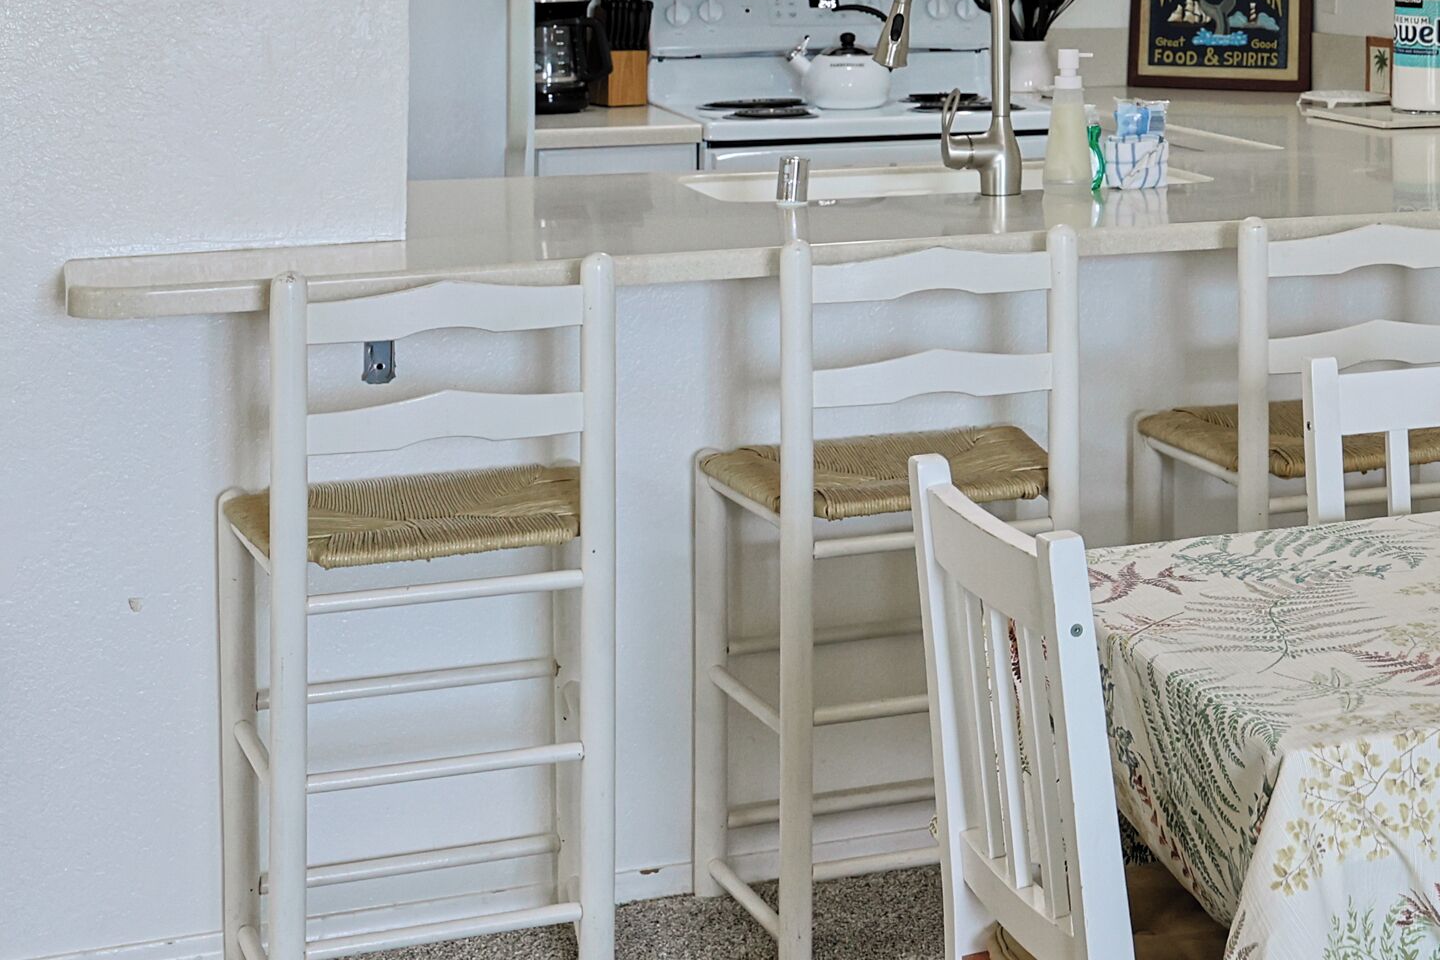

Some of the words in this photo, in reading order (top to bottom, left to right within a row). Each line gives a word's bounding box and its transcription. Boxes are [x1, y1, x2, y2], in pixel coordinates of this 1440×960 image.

[1155, 36, 1186, 48] Great
[1251, 39, 1278, 50] Good
[1204, 47, 1220, 66] &
[1223, 51, 1279, 66] SPIRITS
